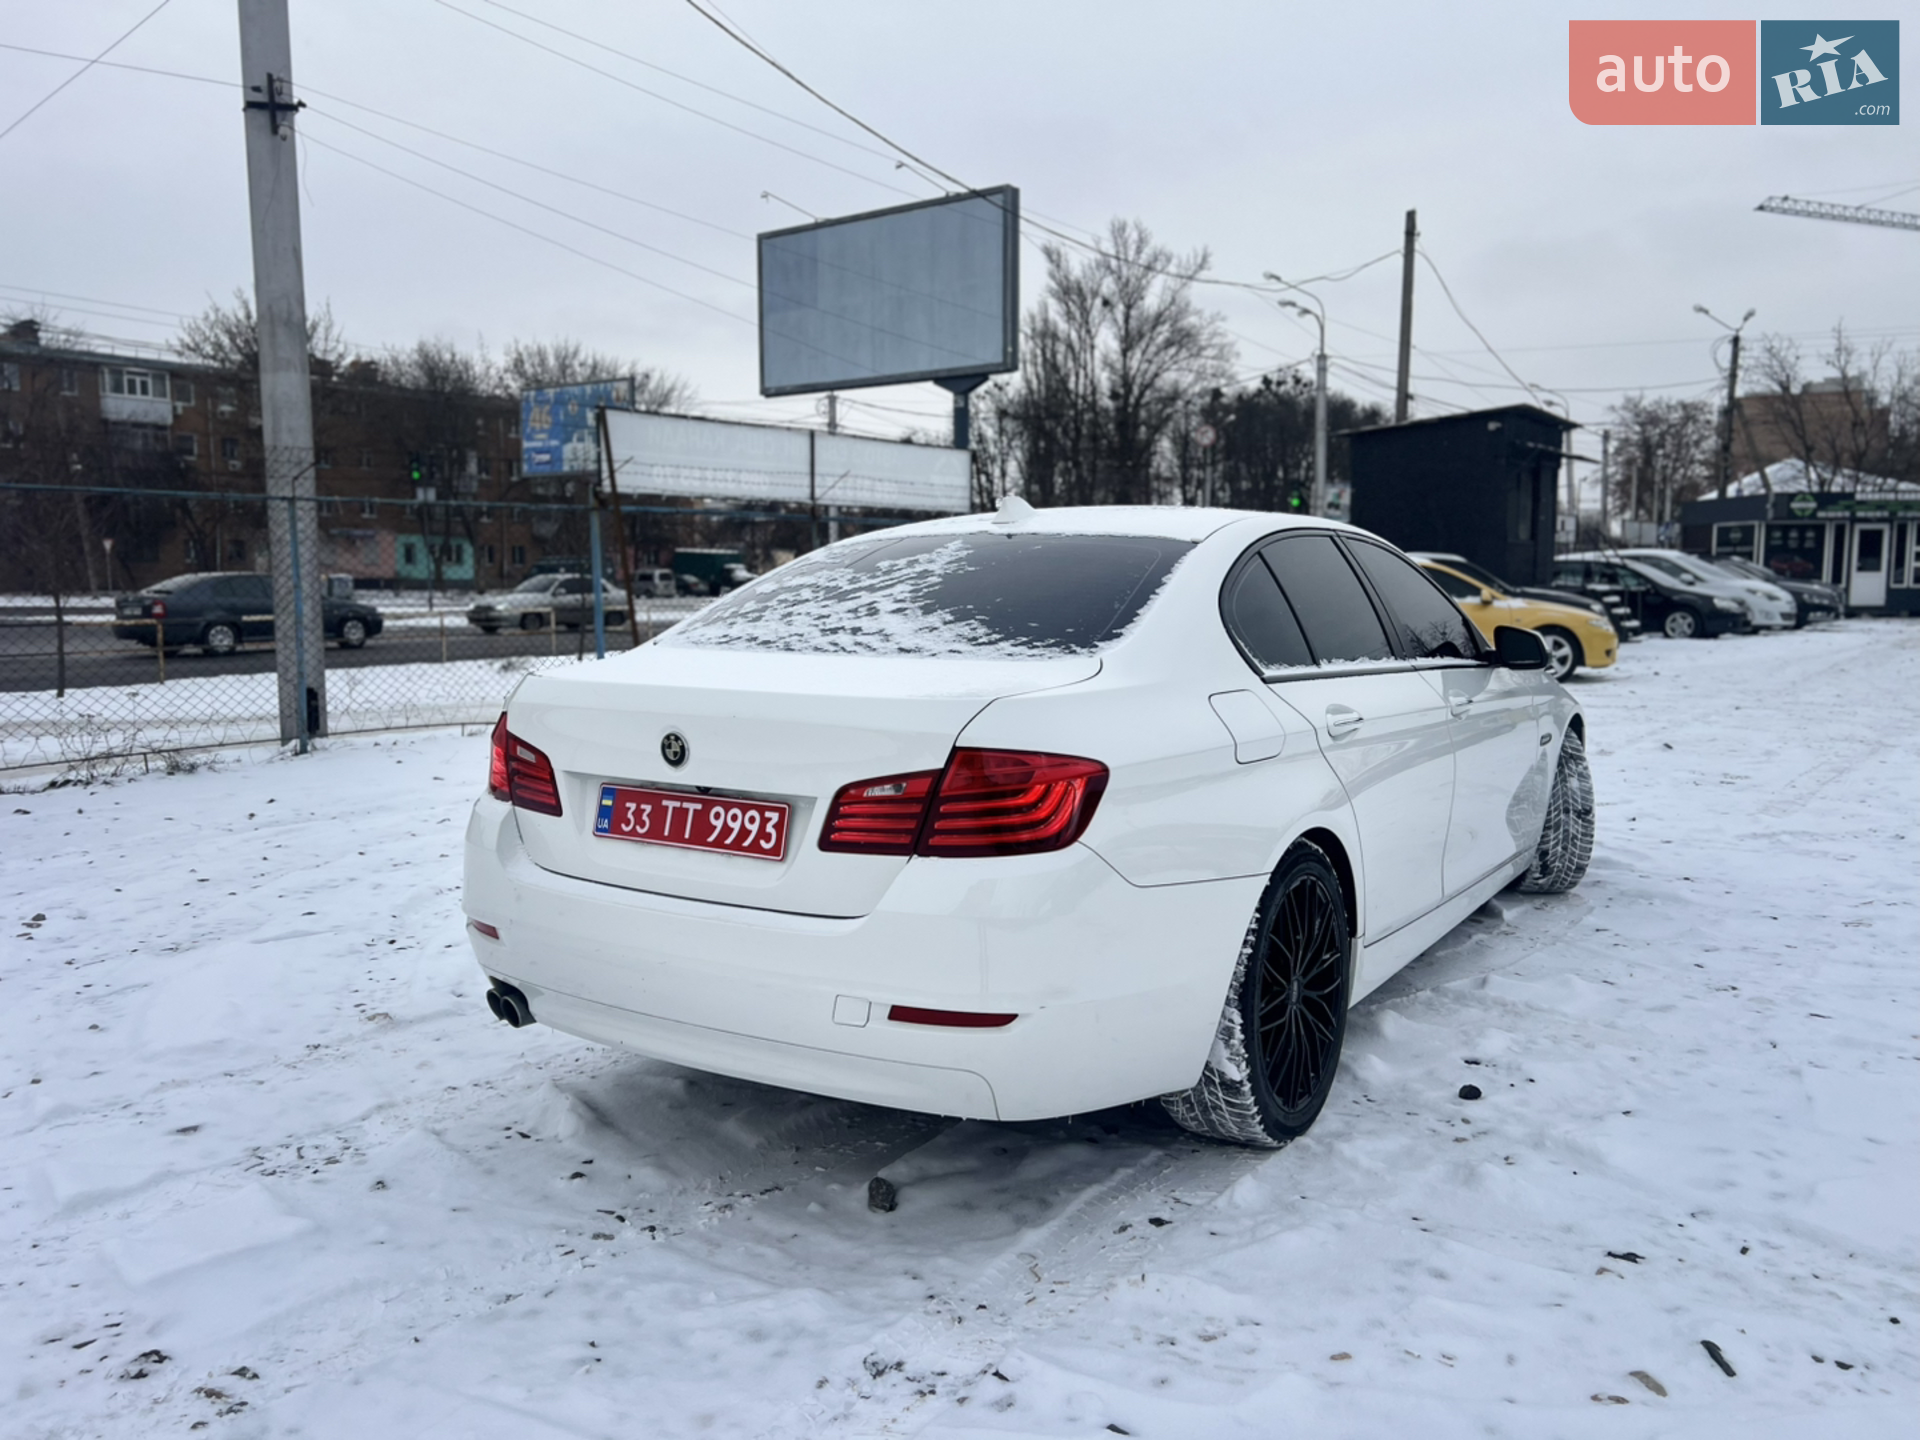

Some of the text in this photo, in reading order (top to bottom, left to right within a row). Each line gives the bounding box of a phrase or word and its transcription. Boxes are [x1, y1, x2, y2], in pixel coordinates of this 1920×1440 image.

[597, 817, 609, 830] UA
[620, 799, 780, 850] 33 TT 9993
